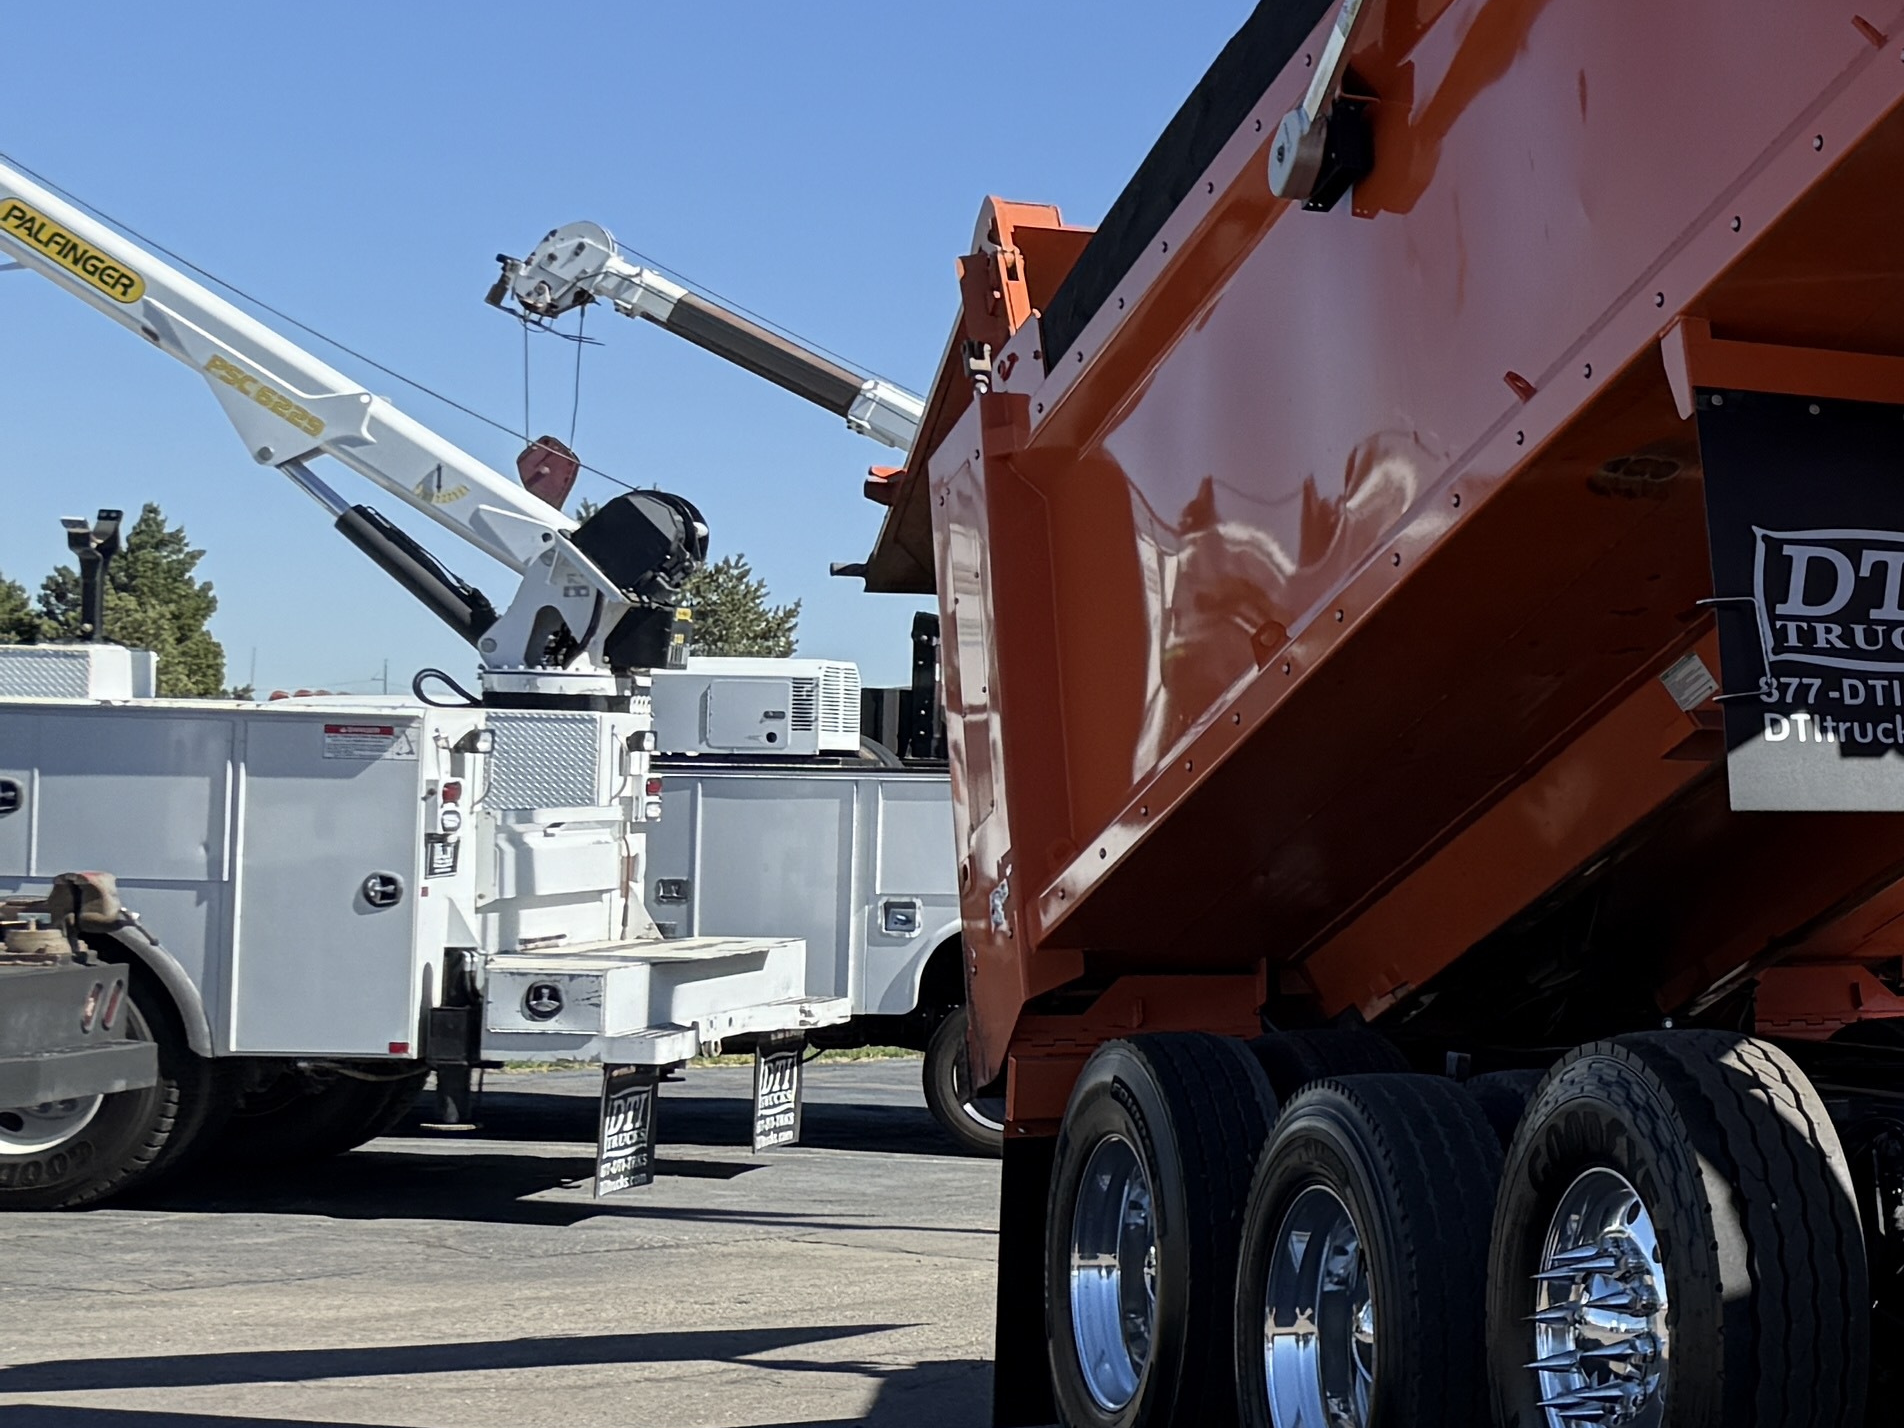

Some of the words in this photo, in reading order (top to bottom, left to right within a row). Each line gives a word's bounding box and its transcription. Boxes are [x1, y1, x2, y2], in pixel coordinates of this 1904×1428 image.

[1, 204, 136, 297] PALFINGER
[203, 354, 257, 396] PSC
[608, 1093, 648, 1135] DTI
